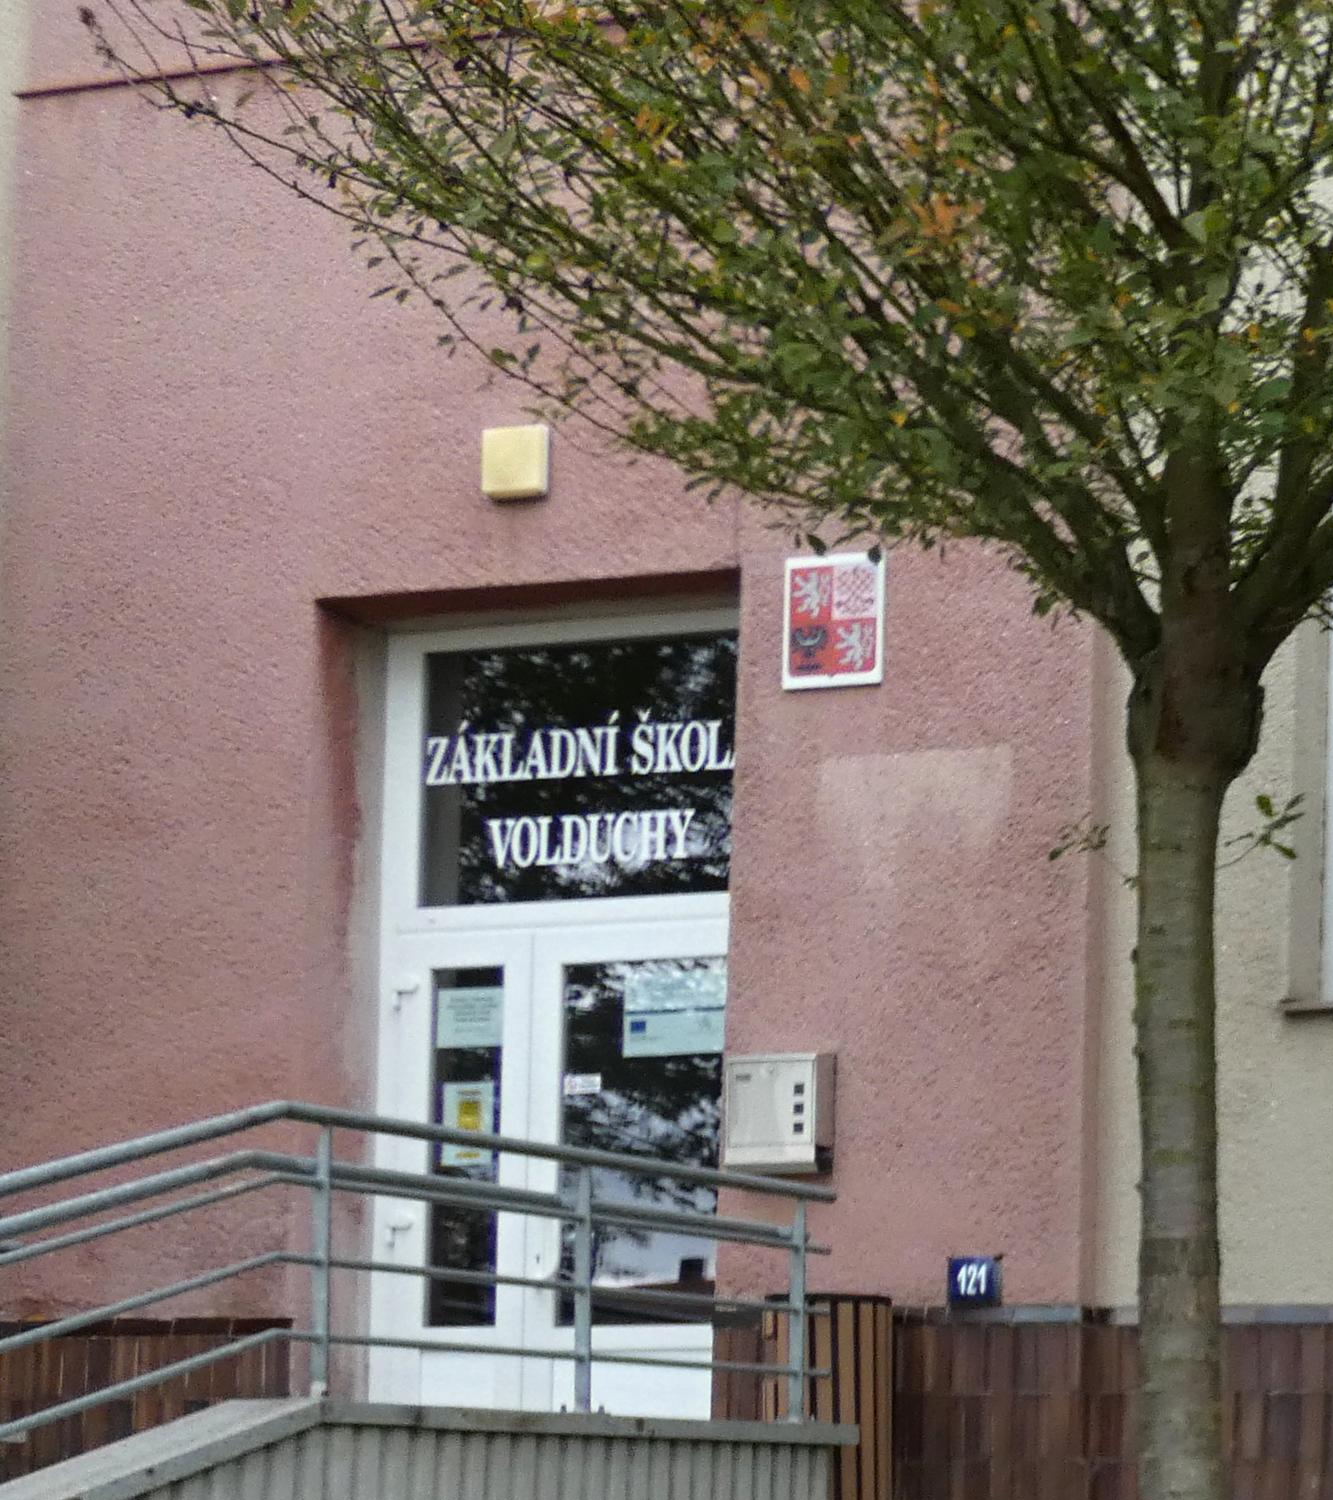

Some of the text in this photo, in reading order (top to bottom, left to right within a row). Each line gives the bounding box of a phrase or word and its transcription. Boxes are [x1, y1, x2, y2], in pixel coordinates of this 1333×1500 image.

[425, 706, 736, 785] ZÁKLADNÍ ŠKOL
[488, 808, 696, 868] VOLDUCHY
[957, 1262, 987, 1296] 121
